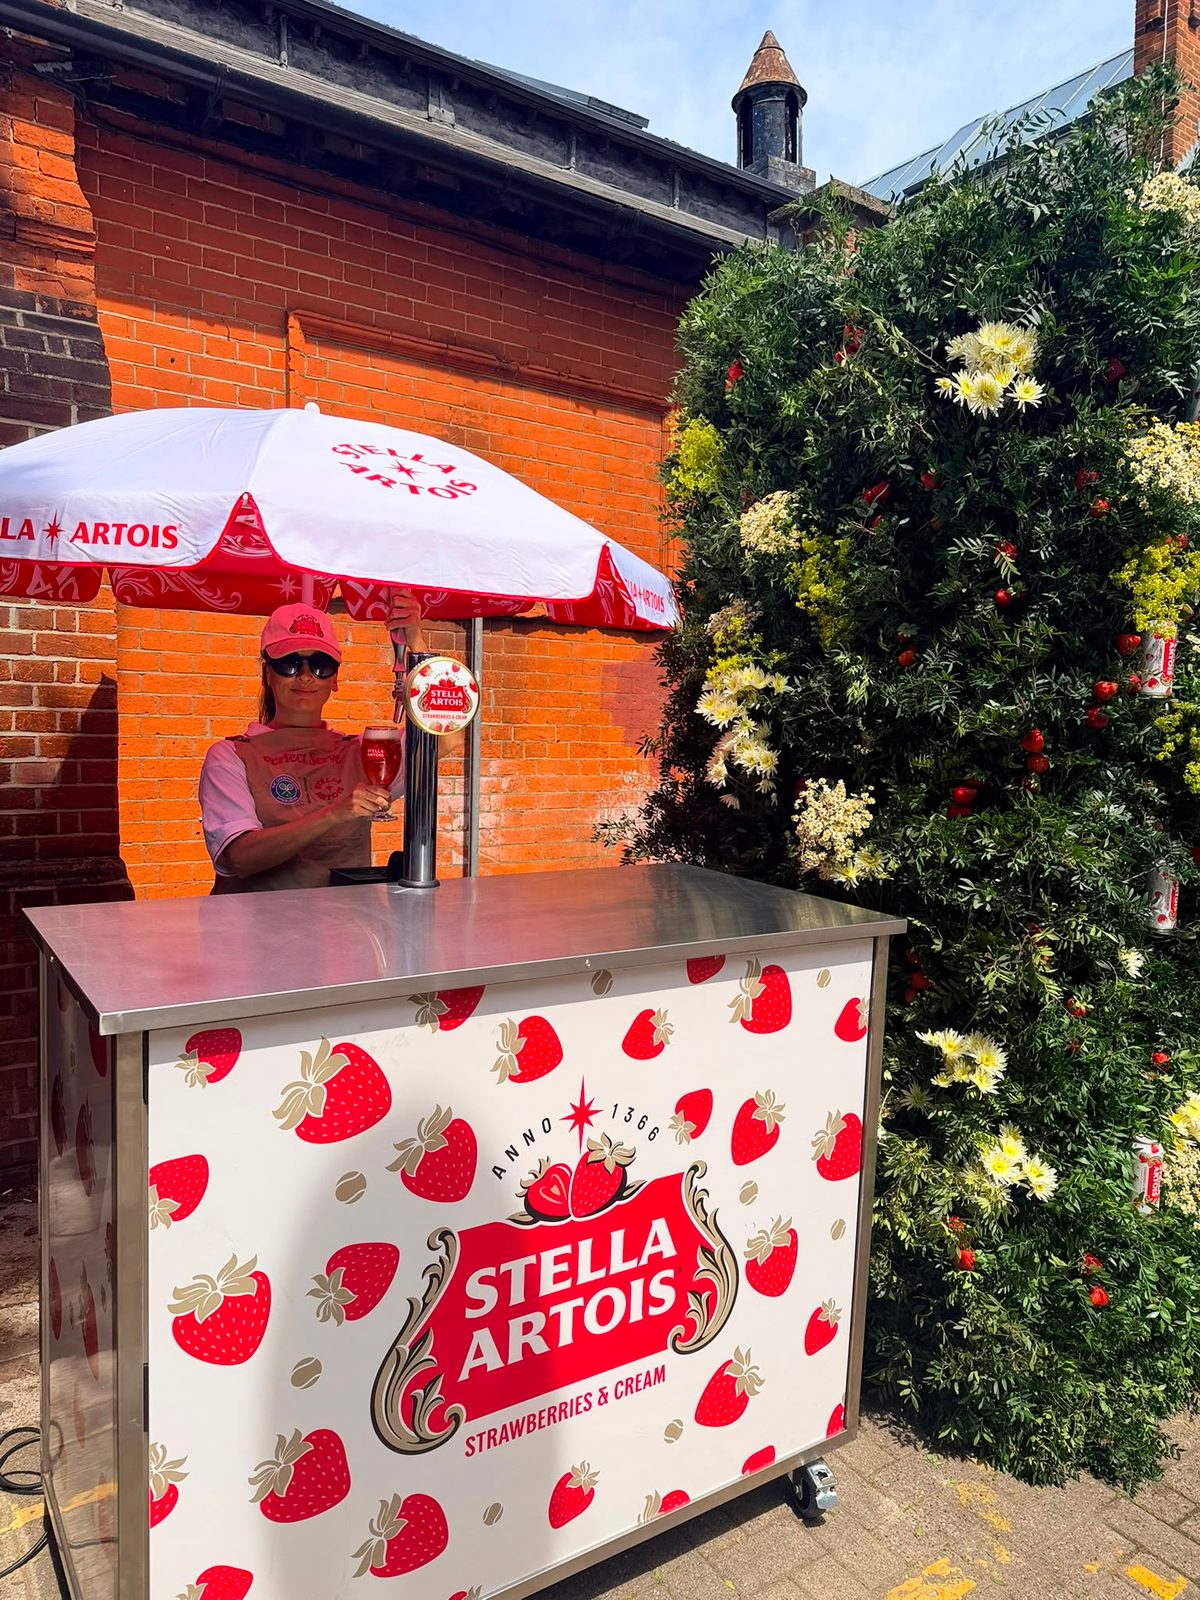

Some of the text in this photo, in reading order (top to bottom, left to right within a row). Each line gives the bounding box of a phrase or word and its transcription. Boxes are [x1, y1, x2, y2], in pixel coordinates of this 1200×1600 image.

[331, 443, 457, 474] STELLA
[338, 461, 478, 499] ARTOIS
[69, 521, 179, 549] ARTOIS
[429, 698, 463, 706] ARTOIS
[430, 689, 463, 698] STELLA
[309, 752, 342, 765] Serve
[492, 1102, 660, 1180] ANNO 1366
[465, 1217, 678, 1319] STELLA
[457, 1269, 677, 1383] ARTOIS
[465, 1364, 667, 1458] STRAWBERRIES & CREAM
